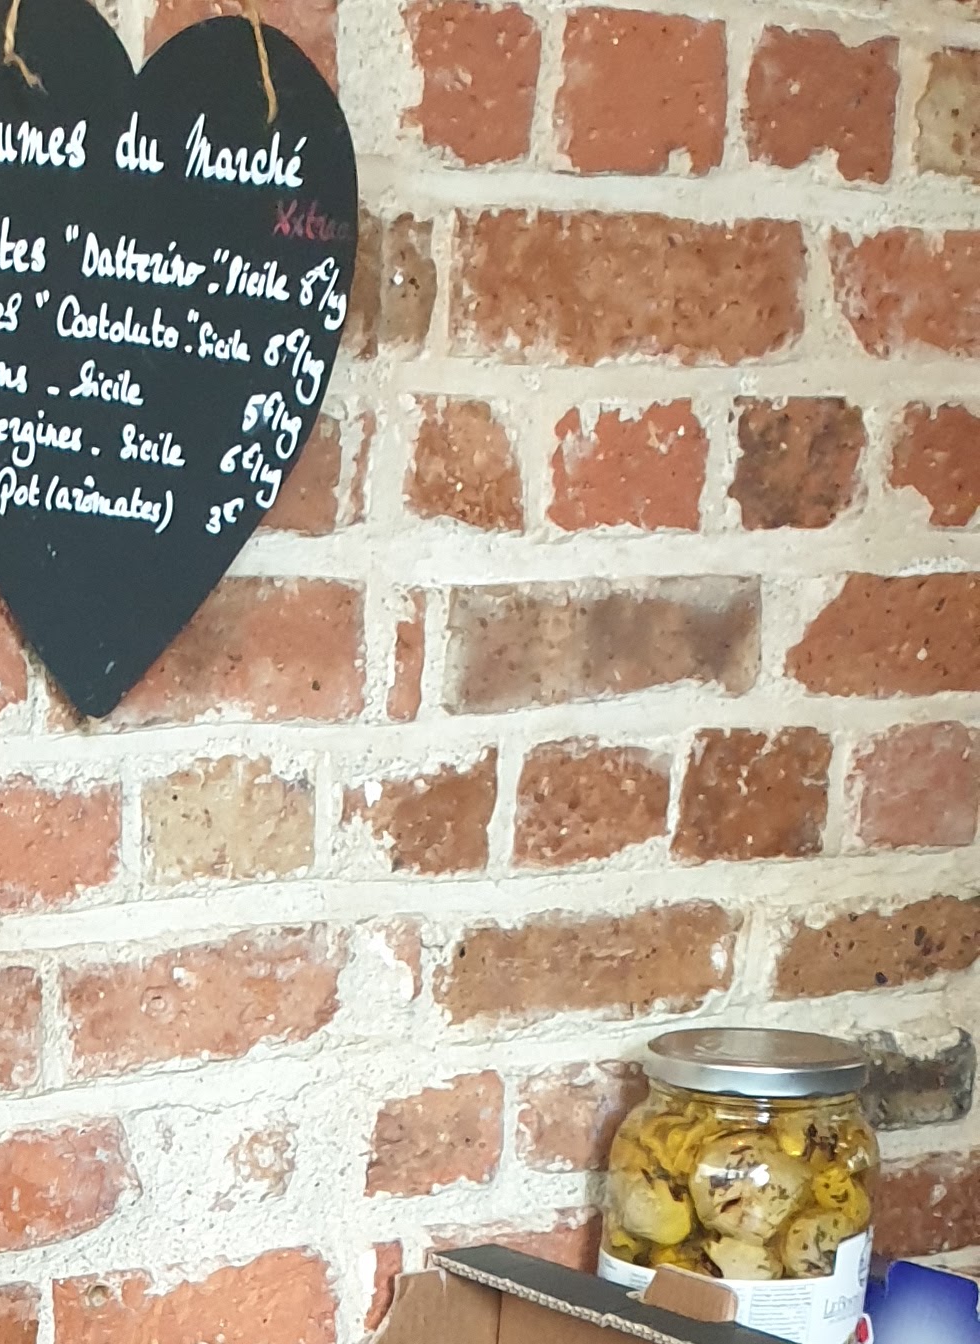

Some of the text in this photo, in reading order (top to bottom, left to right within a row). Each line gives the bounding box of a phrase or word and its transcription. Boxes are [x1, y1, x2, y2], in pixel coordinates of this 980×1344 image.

[116, 111, 164, 174] du
[70, 359, 145, 407] Sicile
[121, 423, 187, 468] Sicile
